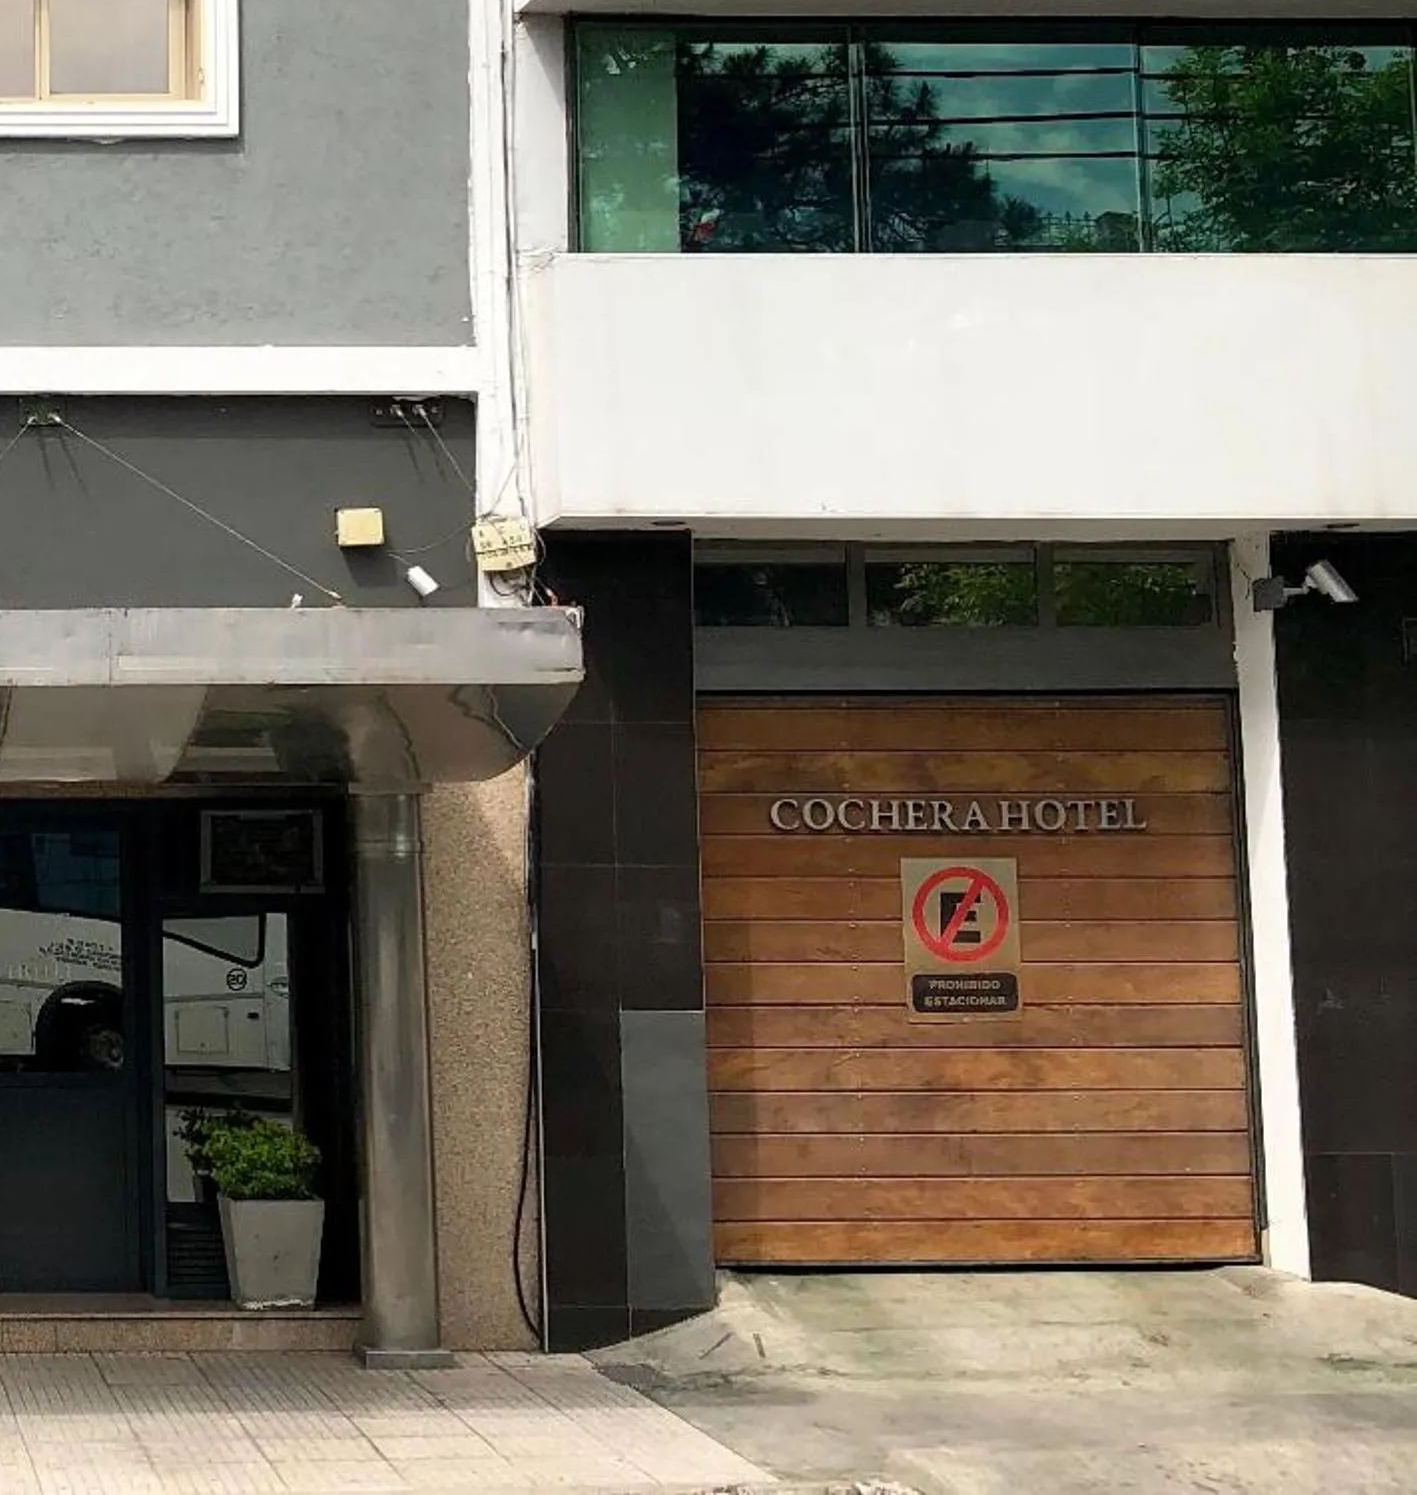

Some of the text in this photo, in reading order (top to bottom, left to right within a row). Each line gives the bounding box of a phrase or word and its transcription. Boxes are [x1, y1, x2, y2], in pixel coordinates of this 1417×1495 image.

[770, 798, 1148, 832] COCHERA HOTEL
[928, 979, 1002, 990] PROHIBIDO
[924, 995, 1007, 1006] ESTACIONAR
